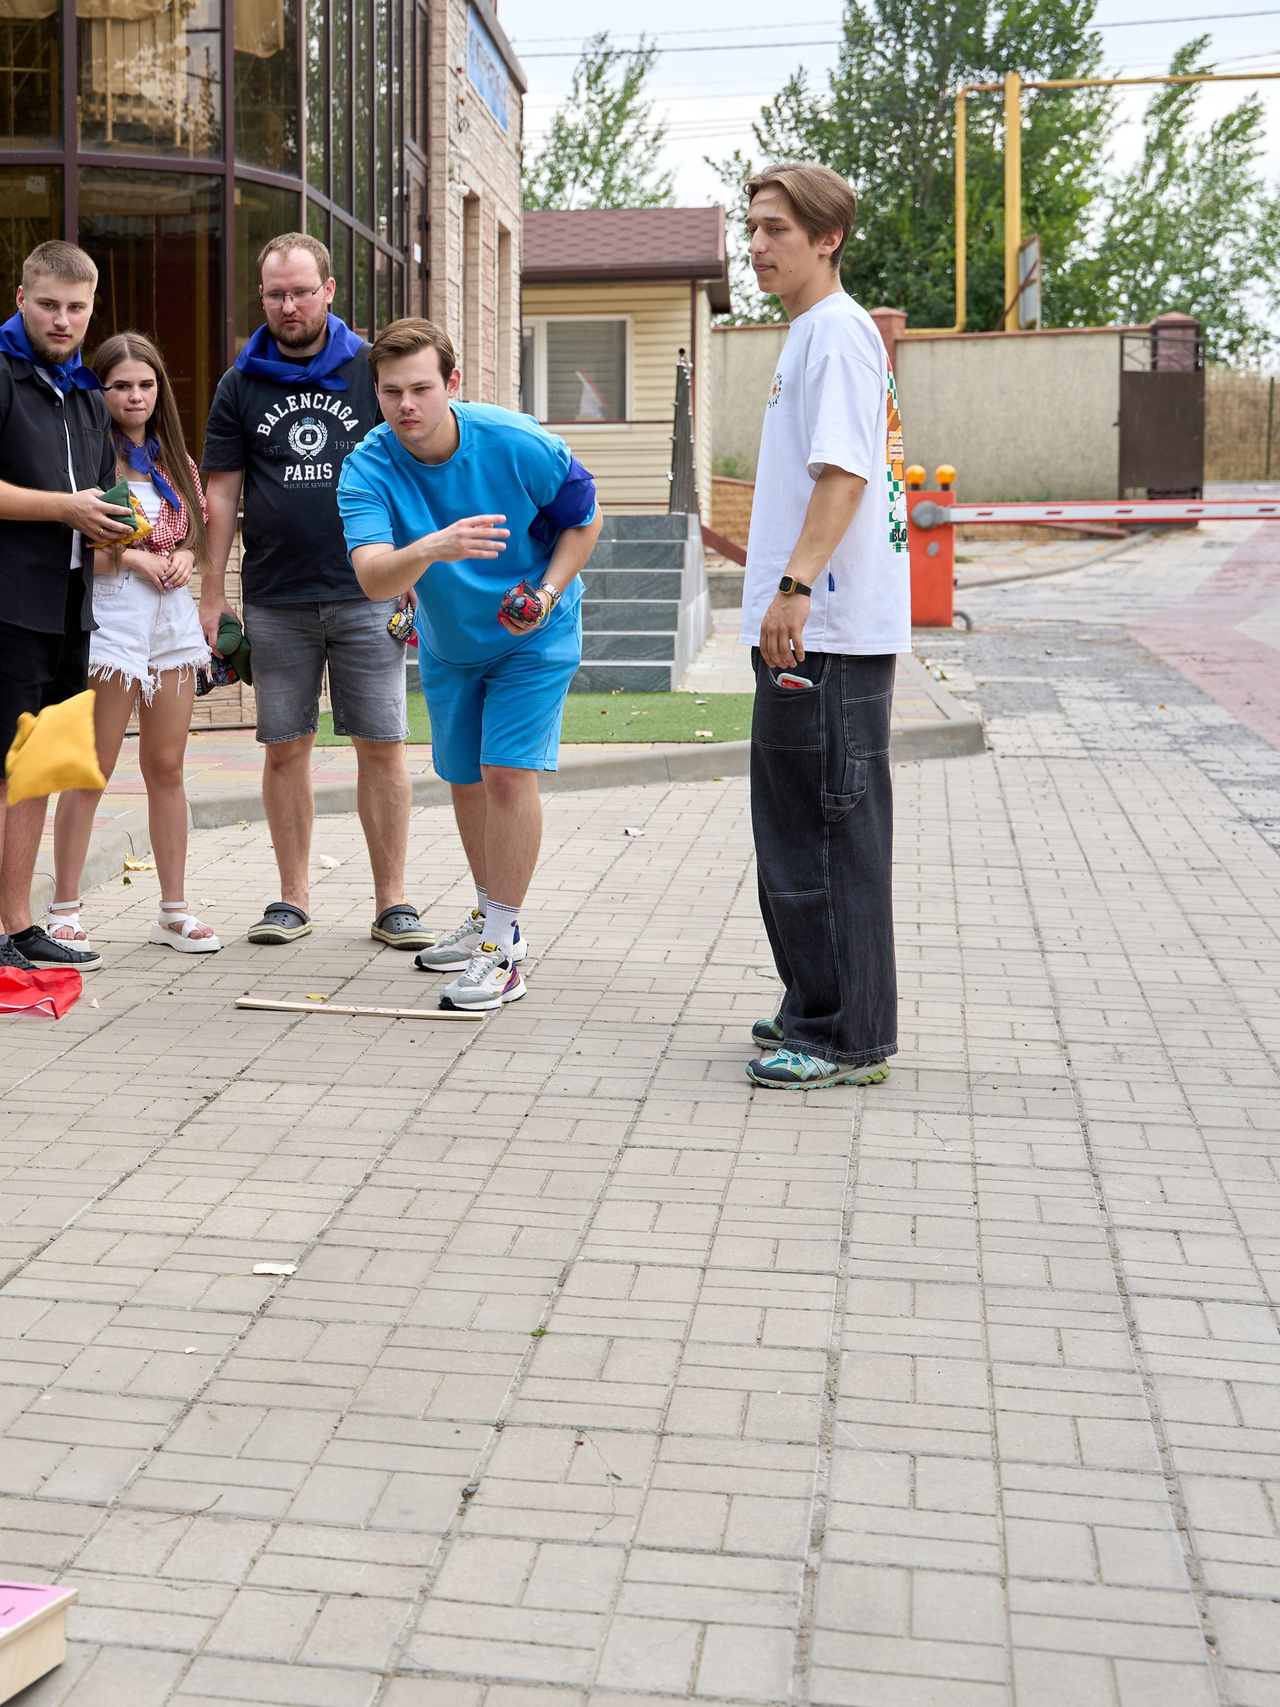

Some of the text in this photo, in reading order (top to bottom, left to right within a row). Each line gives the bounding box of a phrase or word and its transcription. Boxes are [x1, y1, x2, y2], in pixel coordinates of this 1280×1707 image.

[257, 393, 360, 437] BALENCIAGA
[263, 445, 282, 456] EST.
[334, 440, 357, 450] 1917
[283, 463, 333, 482] PARIS
